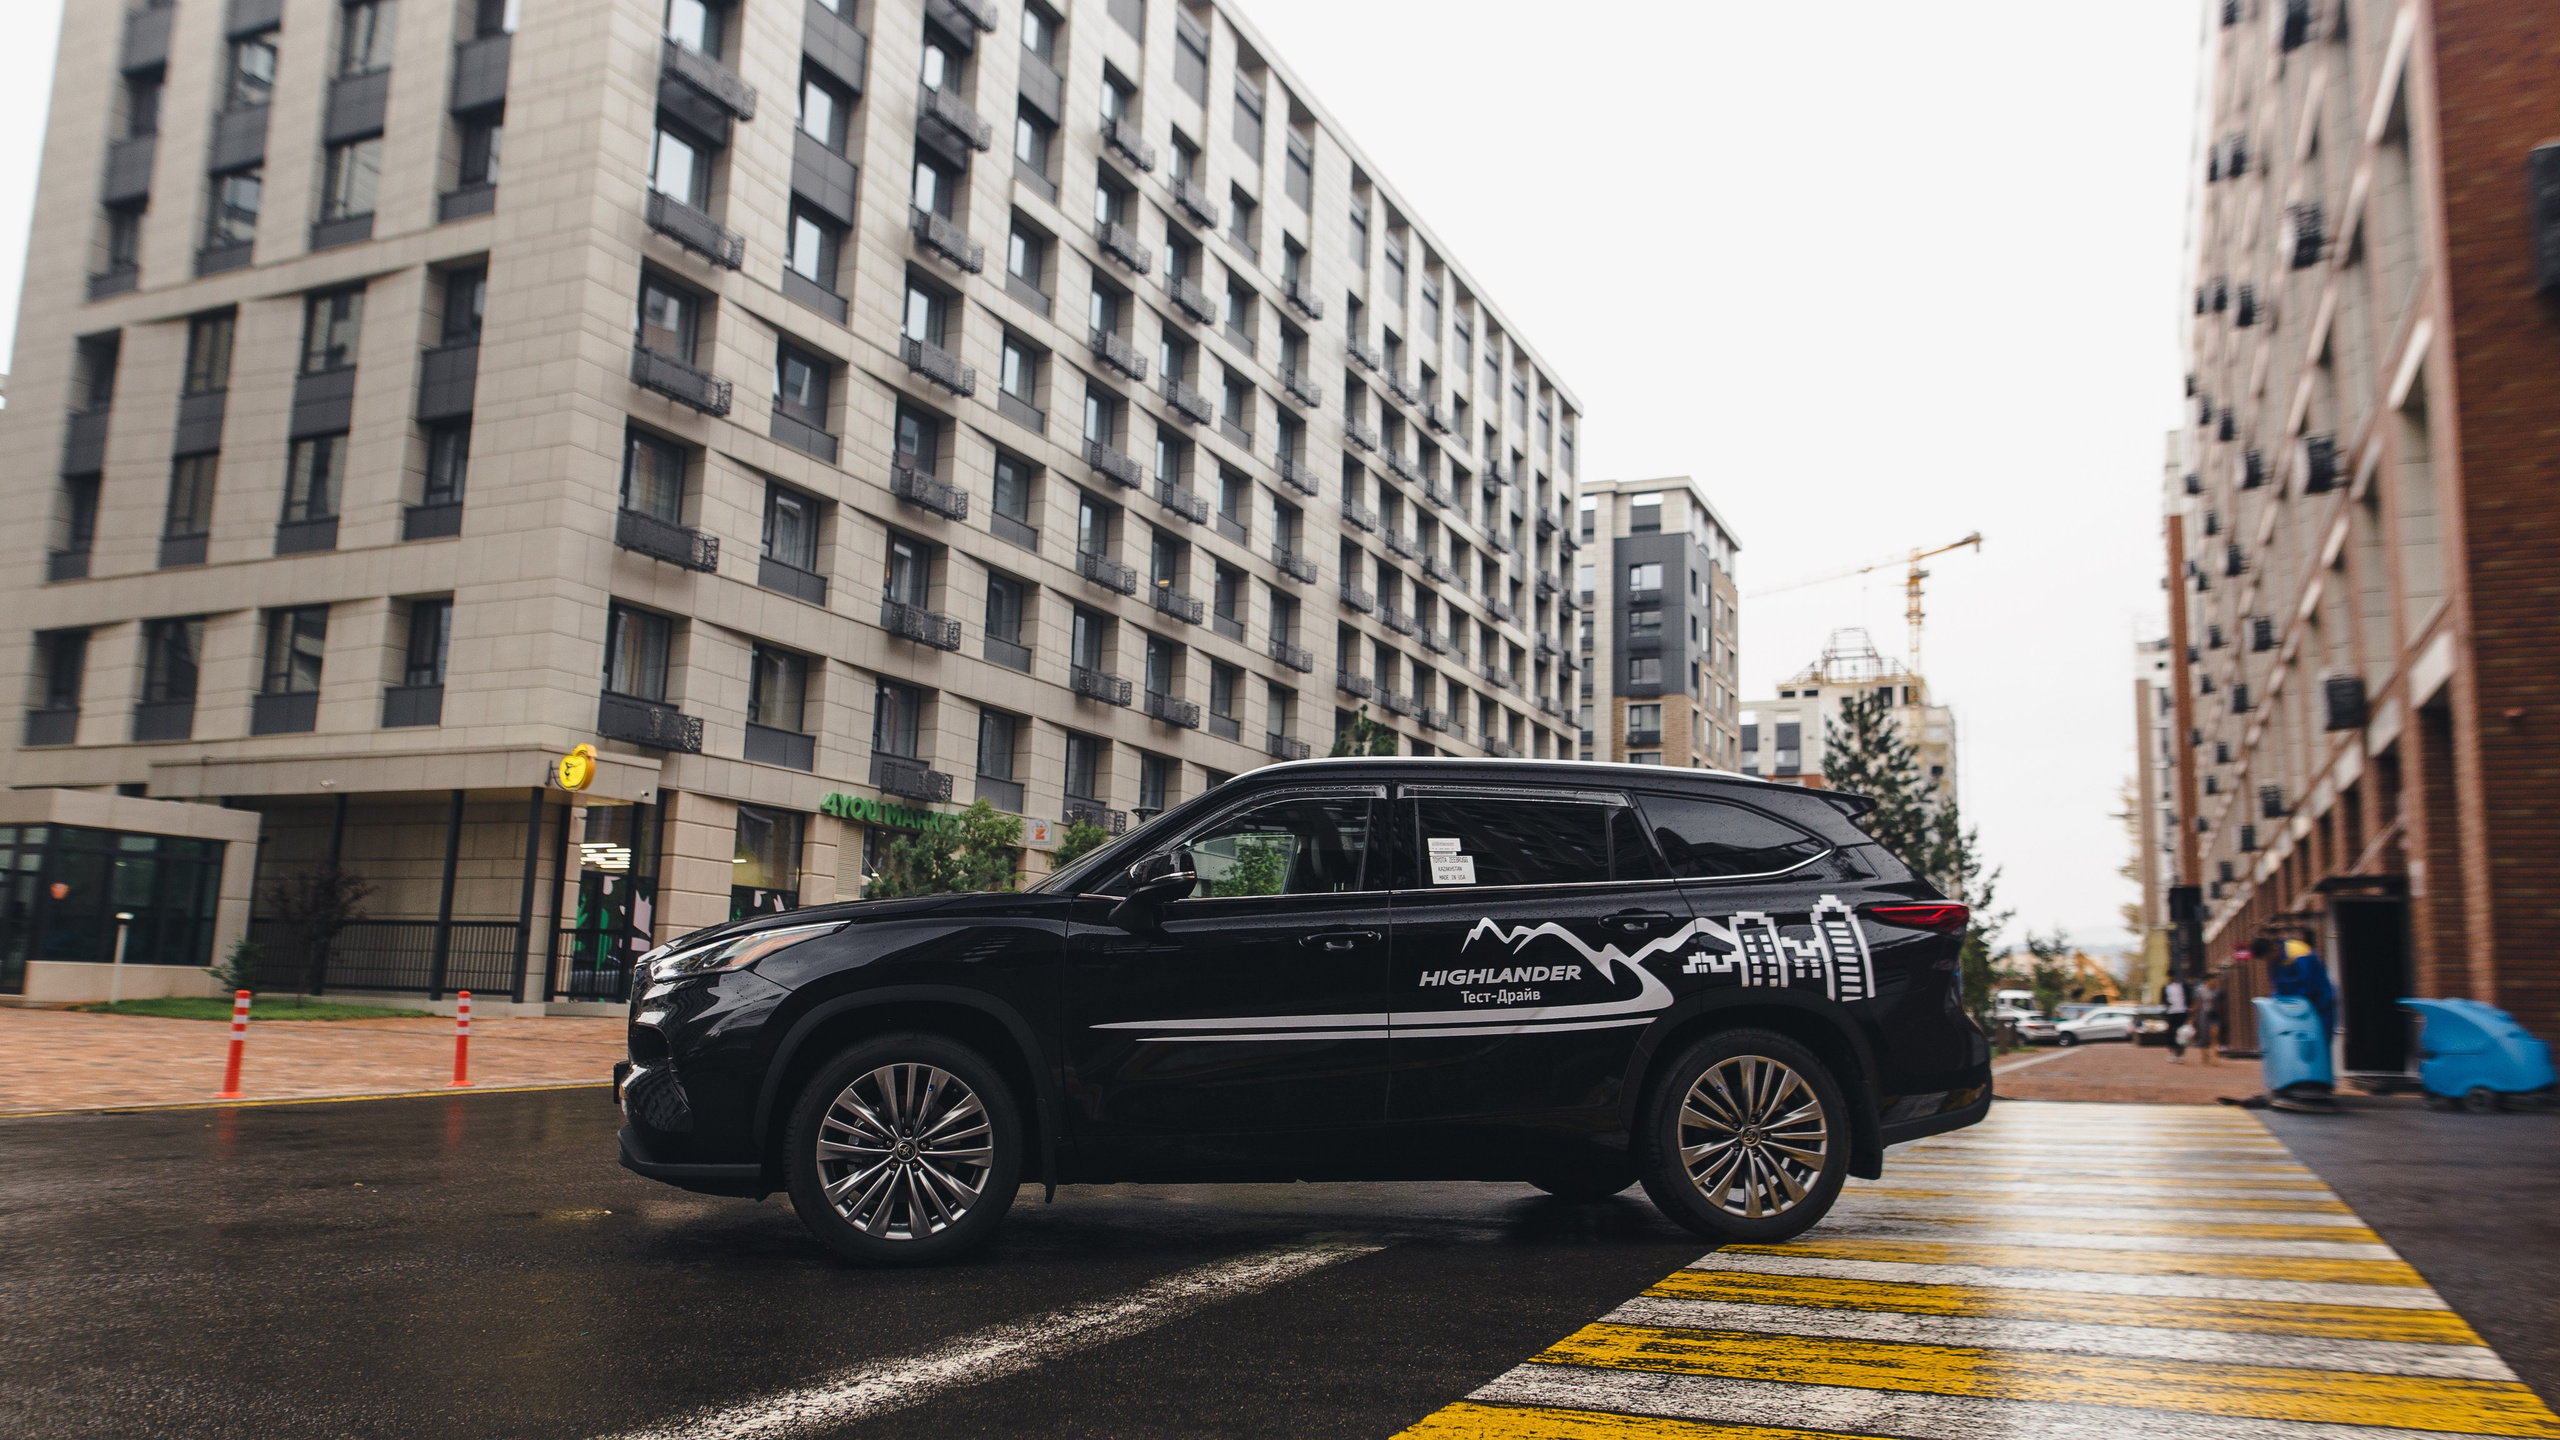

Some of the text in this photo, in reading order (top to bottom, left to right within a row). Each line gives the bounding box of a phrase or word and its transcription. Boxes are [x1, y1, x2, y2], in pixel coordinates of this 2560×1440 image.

[821, 792, 960, 837] 4YOU MARKT
[1419, 965, 1582, 987] HIGHLANDER
[1460, 987, 1541, 1005] Тест-Драйв
